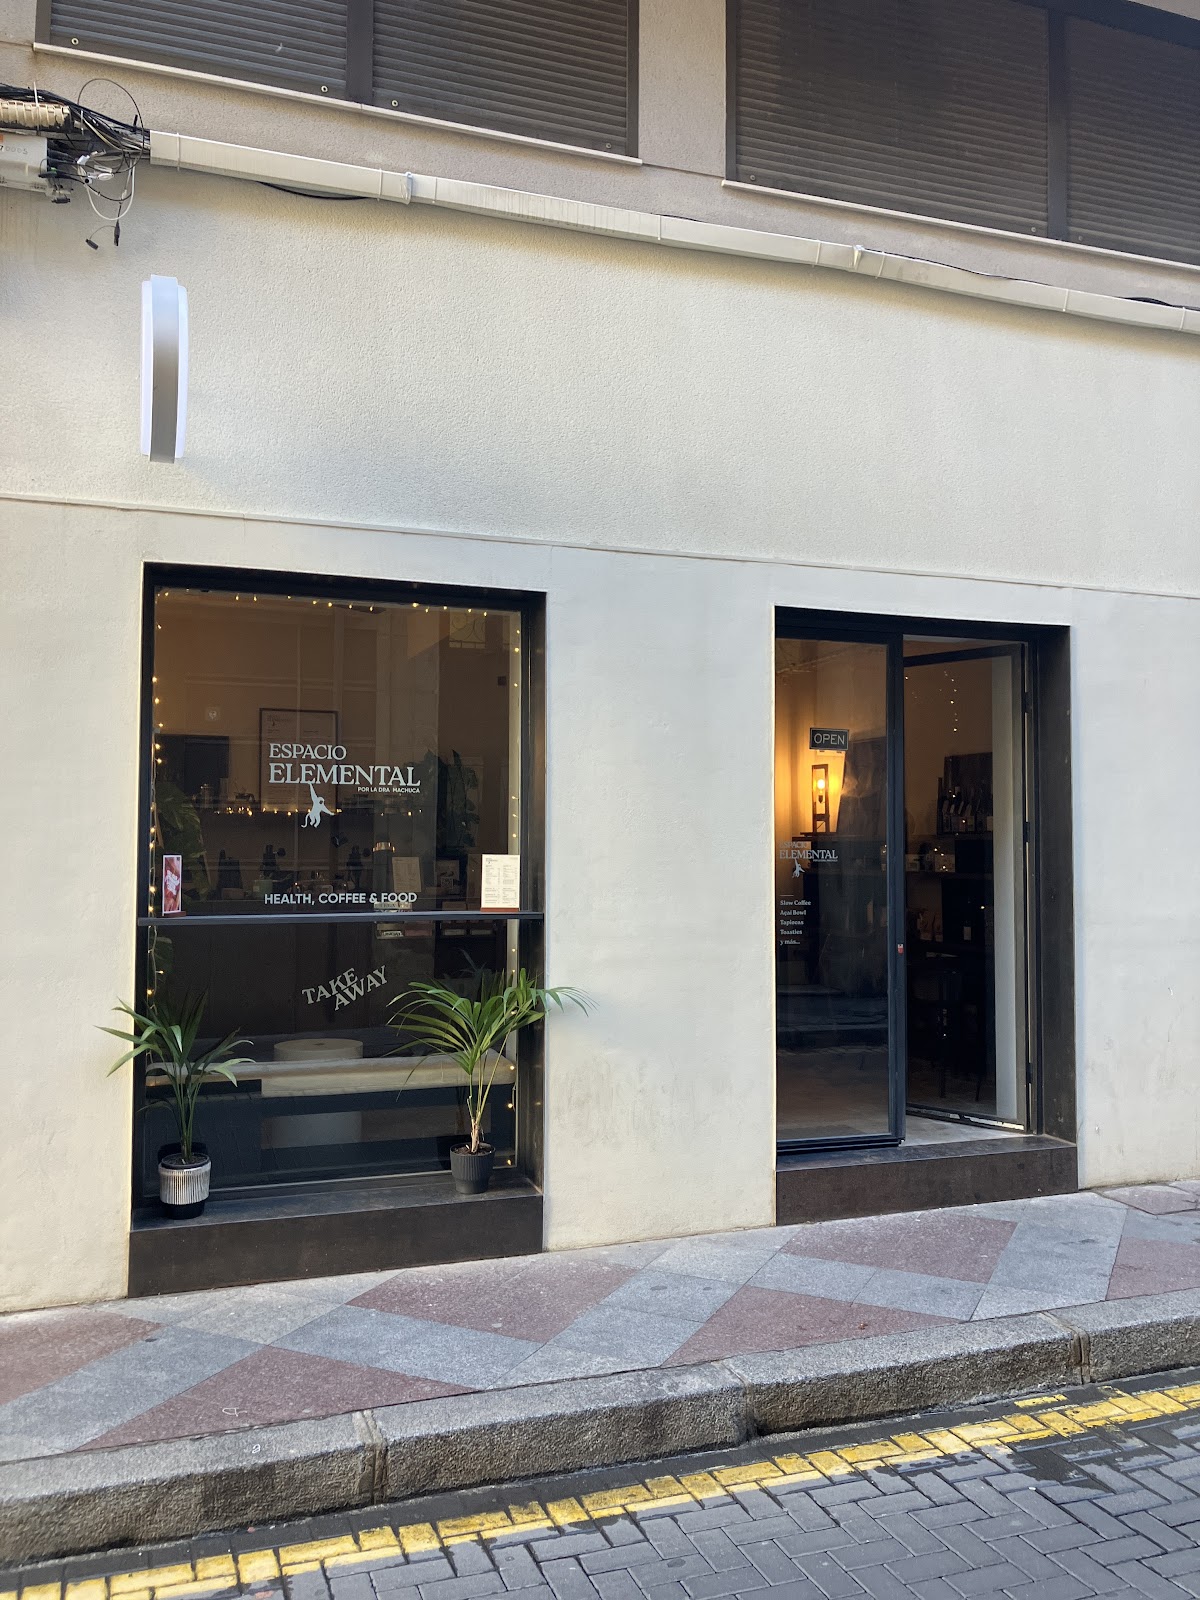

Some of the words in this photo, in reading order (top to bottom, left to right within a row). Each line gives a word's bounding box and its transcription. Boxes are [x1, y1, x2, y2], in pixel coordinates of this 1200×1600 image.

[813, 733, 845, 745] OPEN
[269, 743, 347, 760] ESPACIO
[269, 762, 421, 787] ELEMENTAL
[780, 850, 838, 859] ELEMENTAL
[264, 893, 315, 906] HEALTH,
[318, 892, 366, 904] COFFEE
[368, 892, 378, 904] &
[381, 892, 418, 903] FOOD
[301, 967, 358, 1005] TAKE
[334, 964, 388, 1011] AWAY
